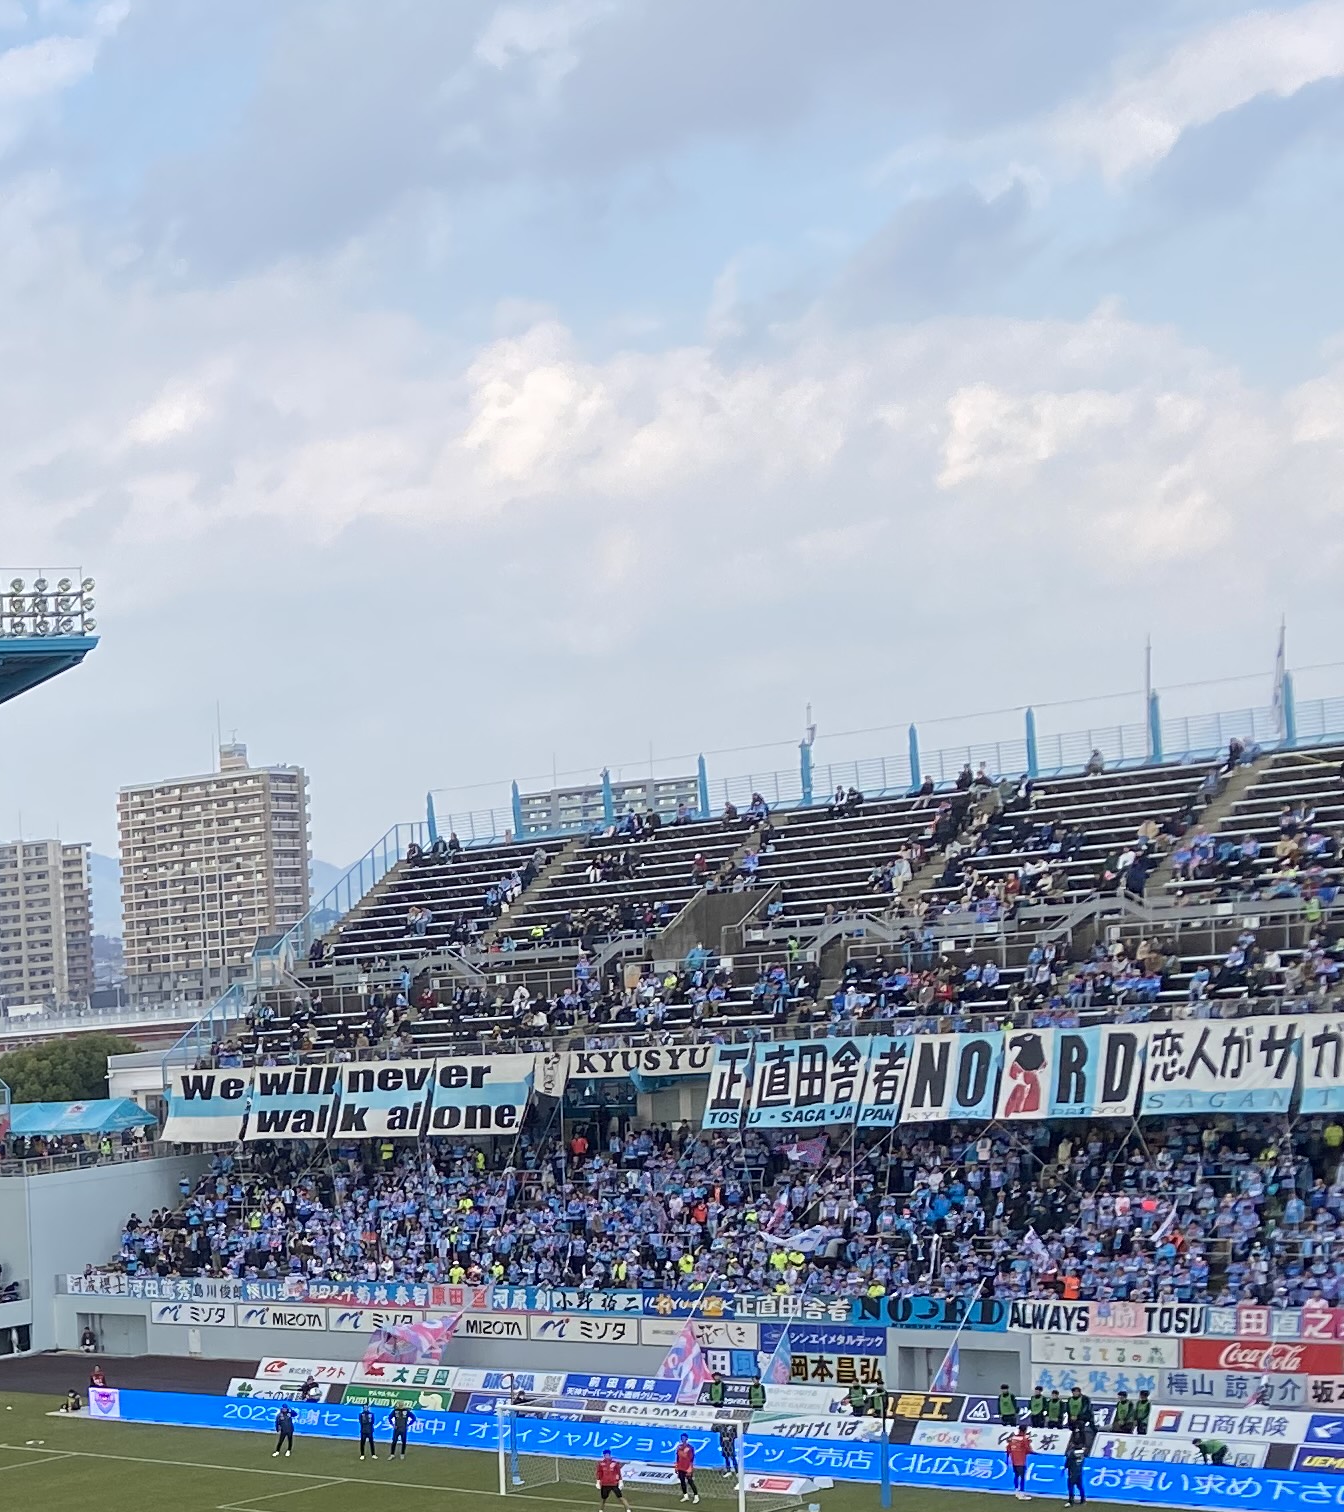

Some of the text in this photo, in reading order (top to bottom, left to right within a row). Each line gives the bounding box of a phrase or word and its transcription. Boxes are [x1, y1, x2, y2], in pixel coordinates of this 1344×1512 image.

[575, 1046, 711, 1074] KYUSYU
[181, 1063, 491, 1101] We will never
[711, 1041, 907, 1110] 正直田舎者
[1146, 1090, 1285, 1109] SAGAN
[256, 1103, 368, 1133] walk
[189, 1306, 226, 1324] ミゾタ
[273, 1312, 322, 1327] MIZOTA
[1009, 1302, 1205, 1334] ALWAYS TOSU
[466, 1320, 522, 1336] MIZOTA
[580, 1320, 627, 1341] ミゾタ
[886, 1394, 953, 1419] 電工
[1188, 1413, 1290, 1437] 日商保険
